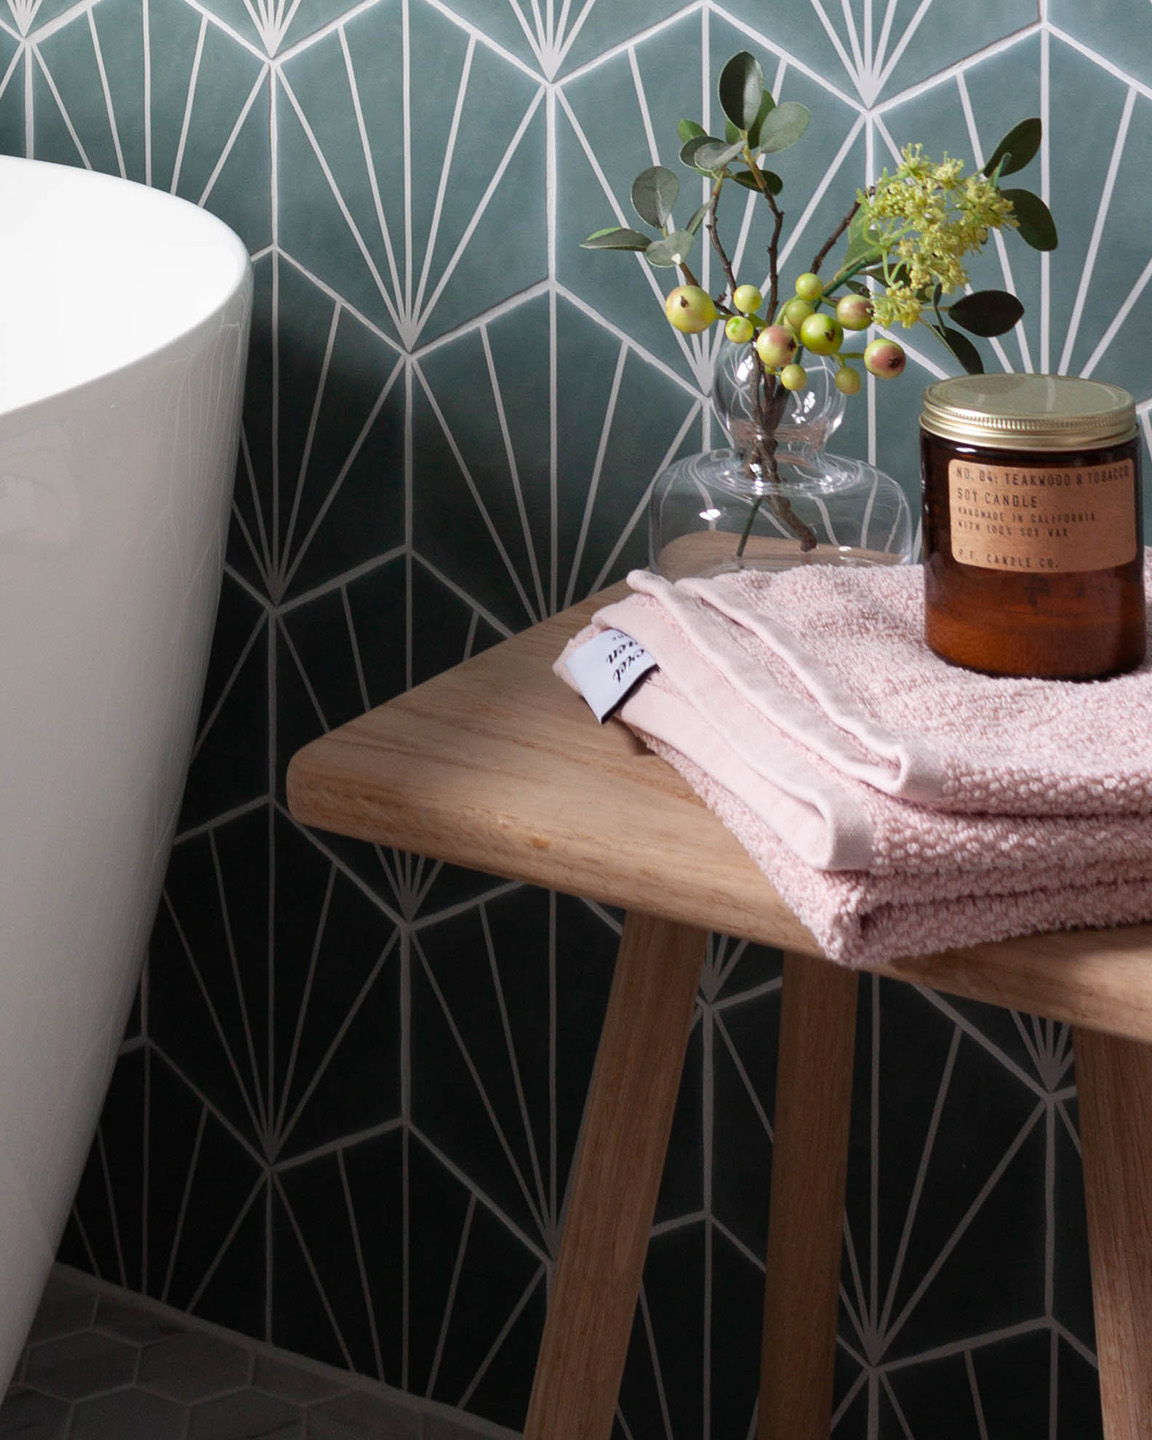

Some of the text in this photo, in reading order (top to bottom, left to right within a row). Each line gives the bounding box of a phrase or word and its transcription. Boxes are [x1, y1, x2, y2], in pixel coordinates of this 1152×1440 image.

[956, 466, 975, 481] NO.
[979, 469, 999, 484] 04:
[1004, 472, 1071, 487] TEAKWOOD
[1088, 464, 1129, 485] TOBACCO
[956, 487, 1038, 509] SOY CANDLE
[957, 506, 1096, 525] HANDMADE IN CALIFORNIA
[957, 520, 1069, 538] WITH 100% SOY WAX
[986, 553, 1031, 569] CANDLE
[1039, 557, 1059, 569] CO.
